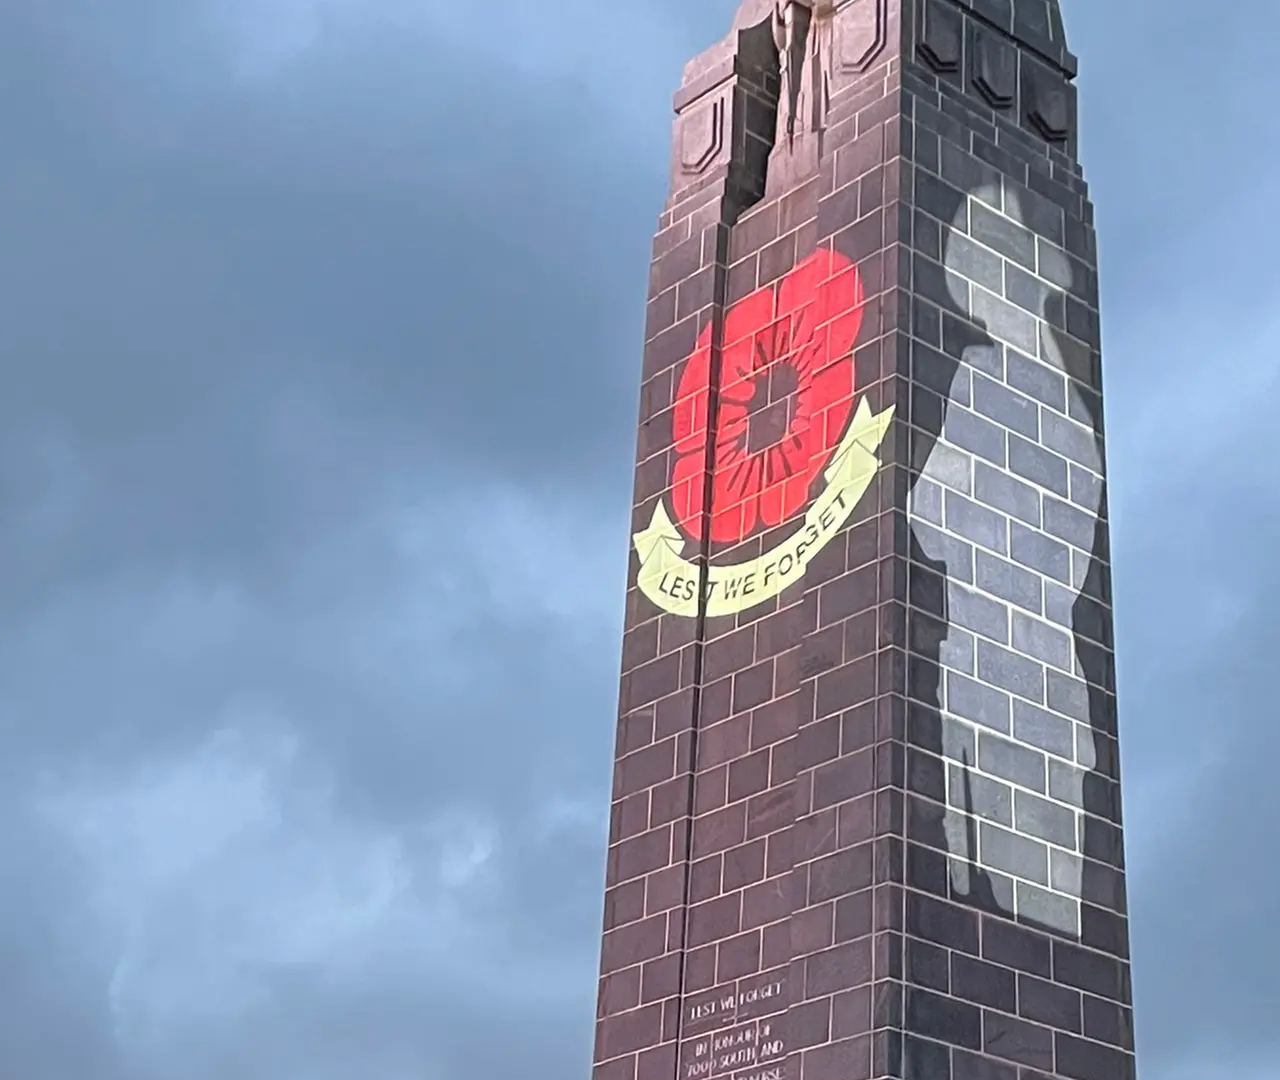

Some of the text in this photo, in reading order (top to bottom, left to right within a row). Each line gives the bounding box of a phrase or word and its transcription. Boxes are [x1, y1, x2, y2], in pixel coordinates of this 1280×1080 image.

[658, 488, 848, 602] LEST WE FORGET
[691, 1001, 716, 1019] LEST
[695, 1042, 708, 1057] IN
[720, 1040, 784, 1069] SOUTHAND
